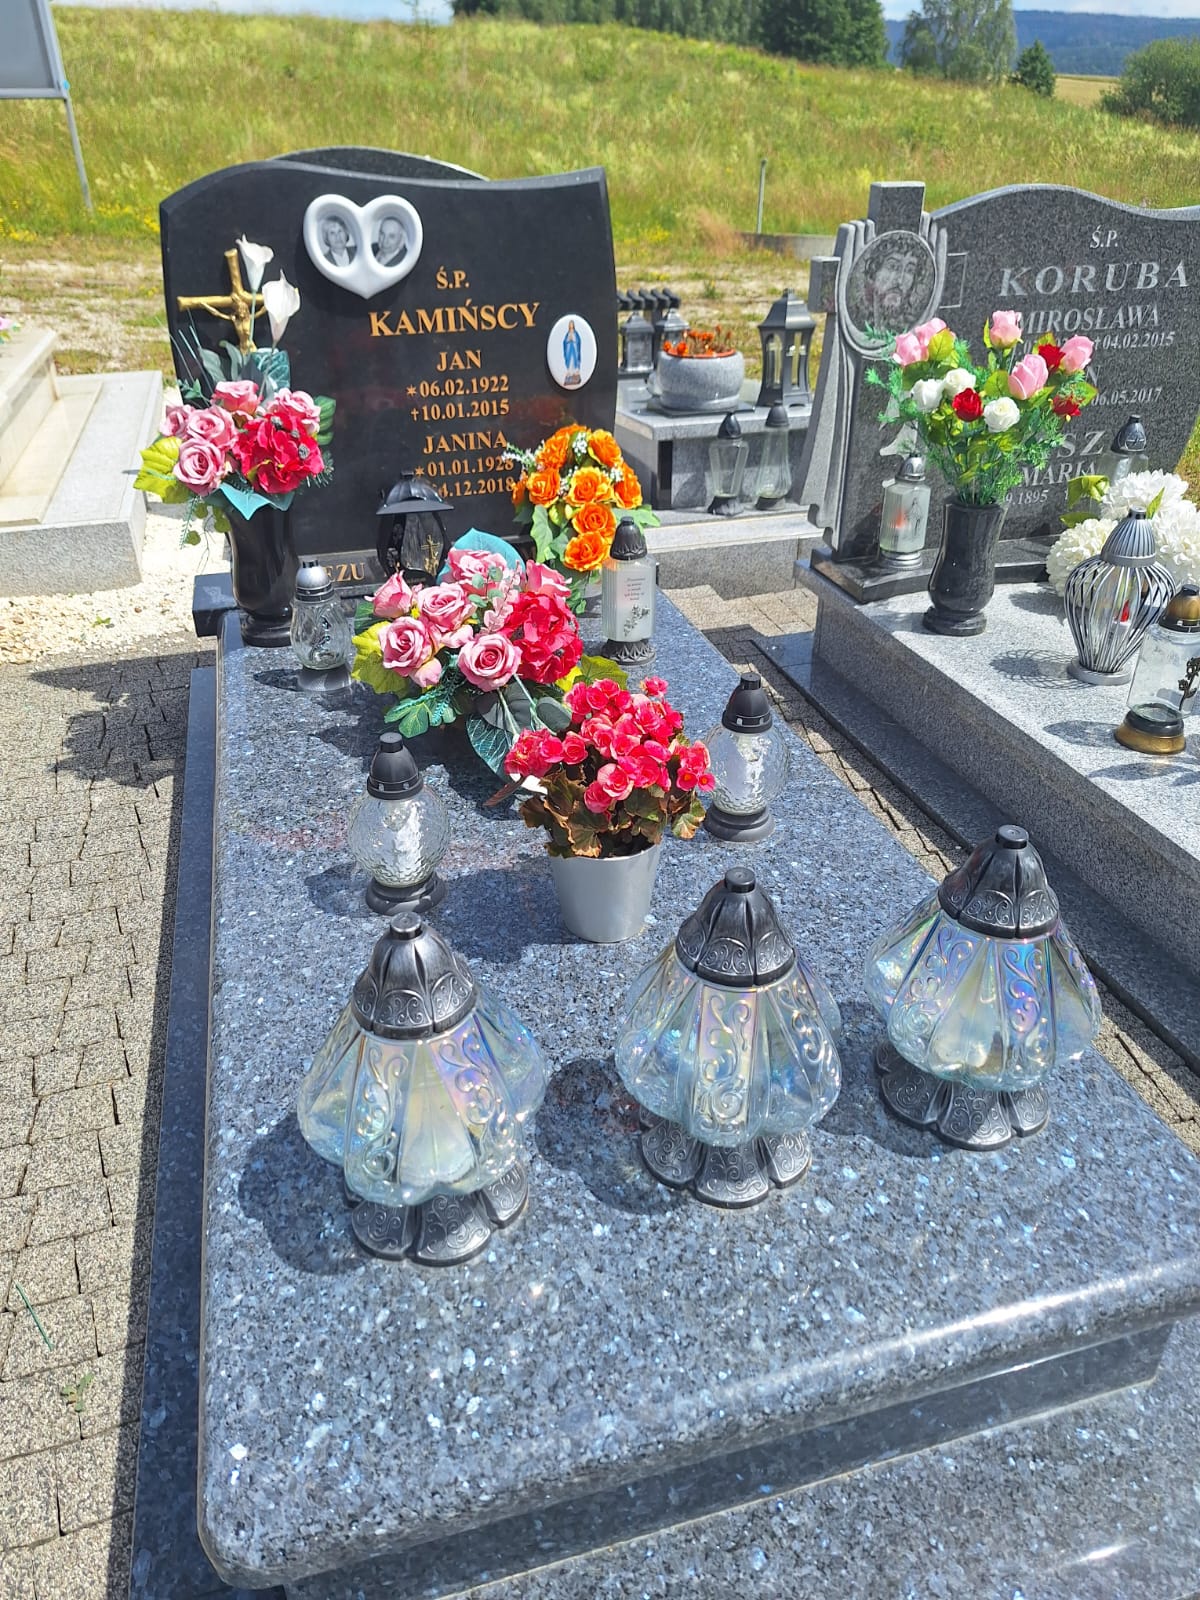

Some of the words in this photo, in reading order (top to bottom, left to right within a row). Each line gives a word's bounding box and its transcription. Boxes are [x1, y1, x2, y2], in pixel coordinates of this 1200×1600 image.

[1090, 225, 1118, 248] Ś.P.
[436, 266, 470, 289] Ś.P.
[998, 260, 1189, 297] KORUBA
[368, 298, 541, 337] KAMIŃSCY
[1018, 304, 1160, 334] MIROSŁAWA
[1103, 331, 1175, 349] 04.02.2015
[436, 349, 481, 372] JAN
[423, 430, 508, 454] JANINA
